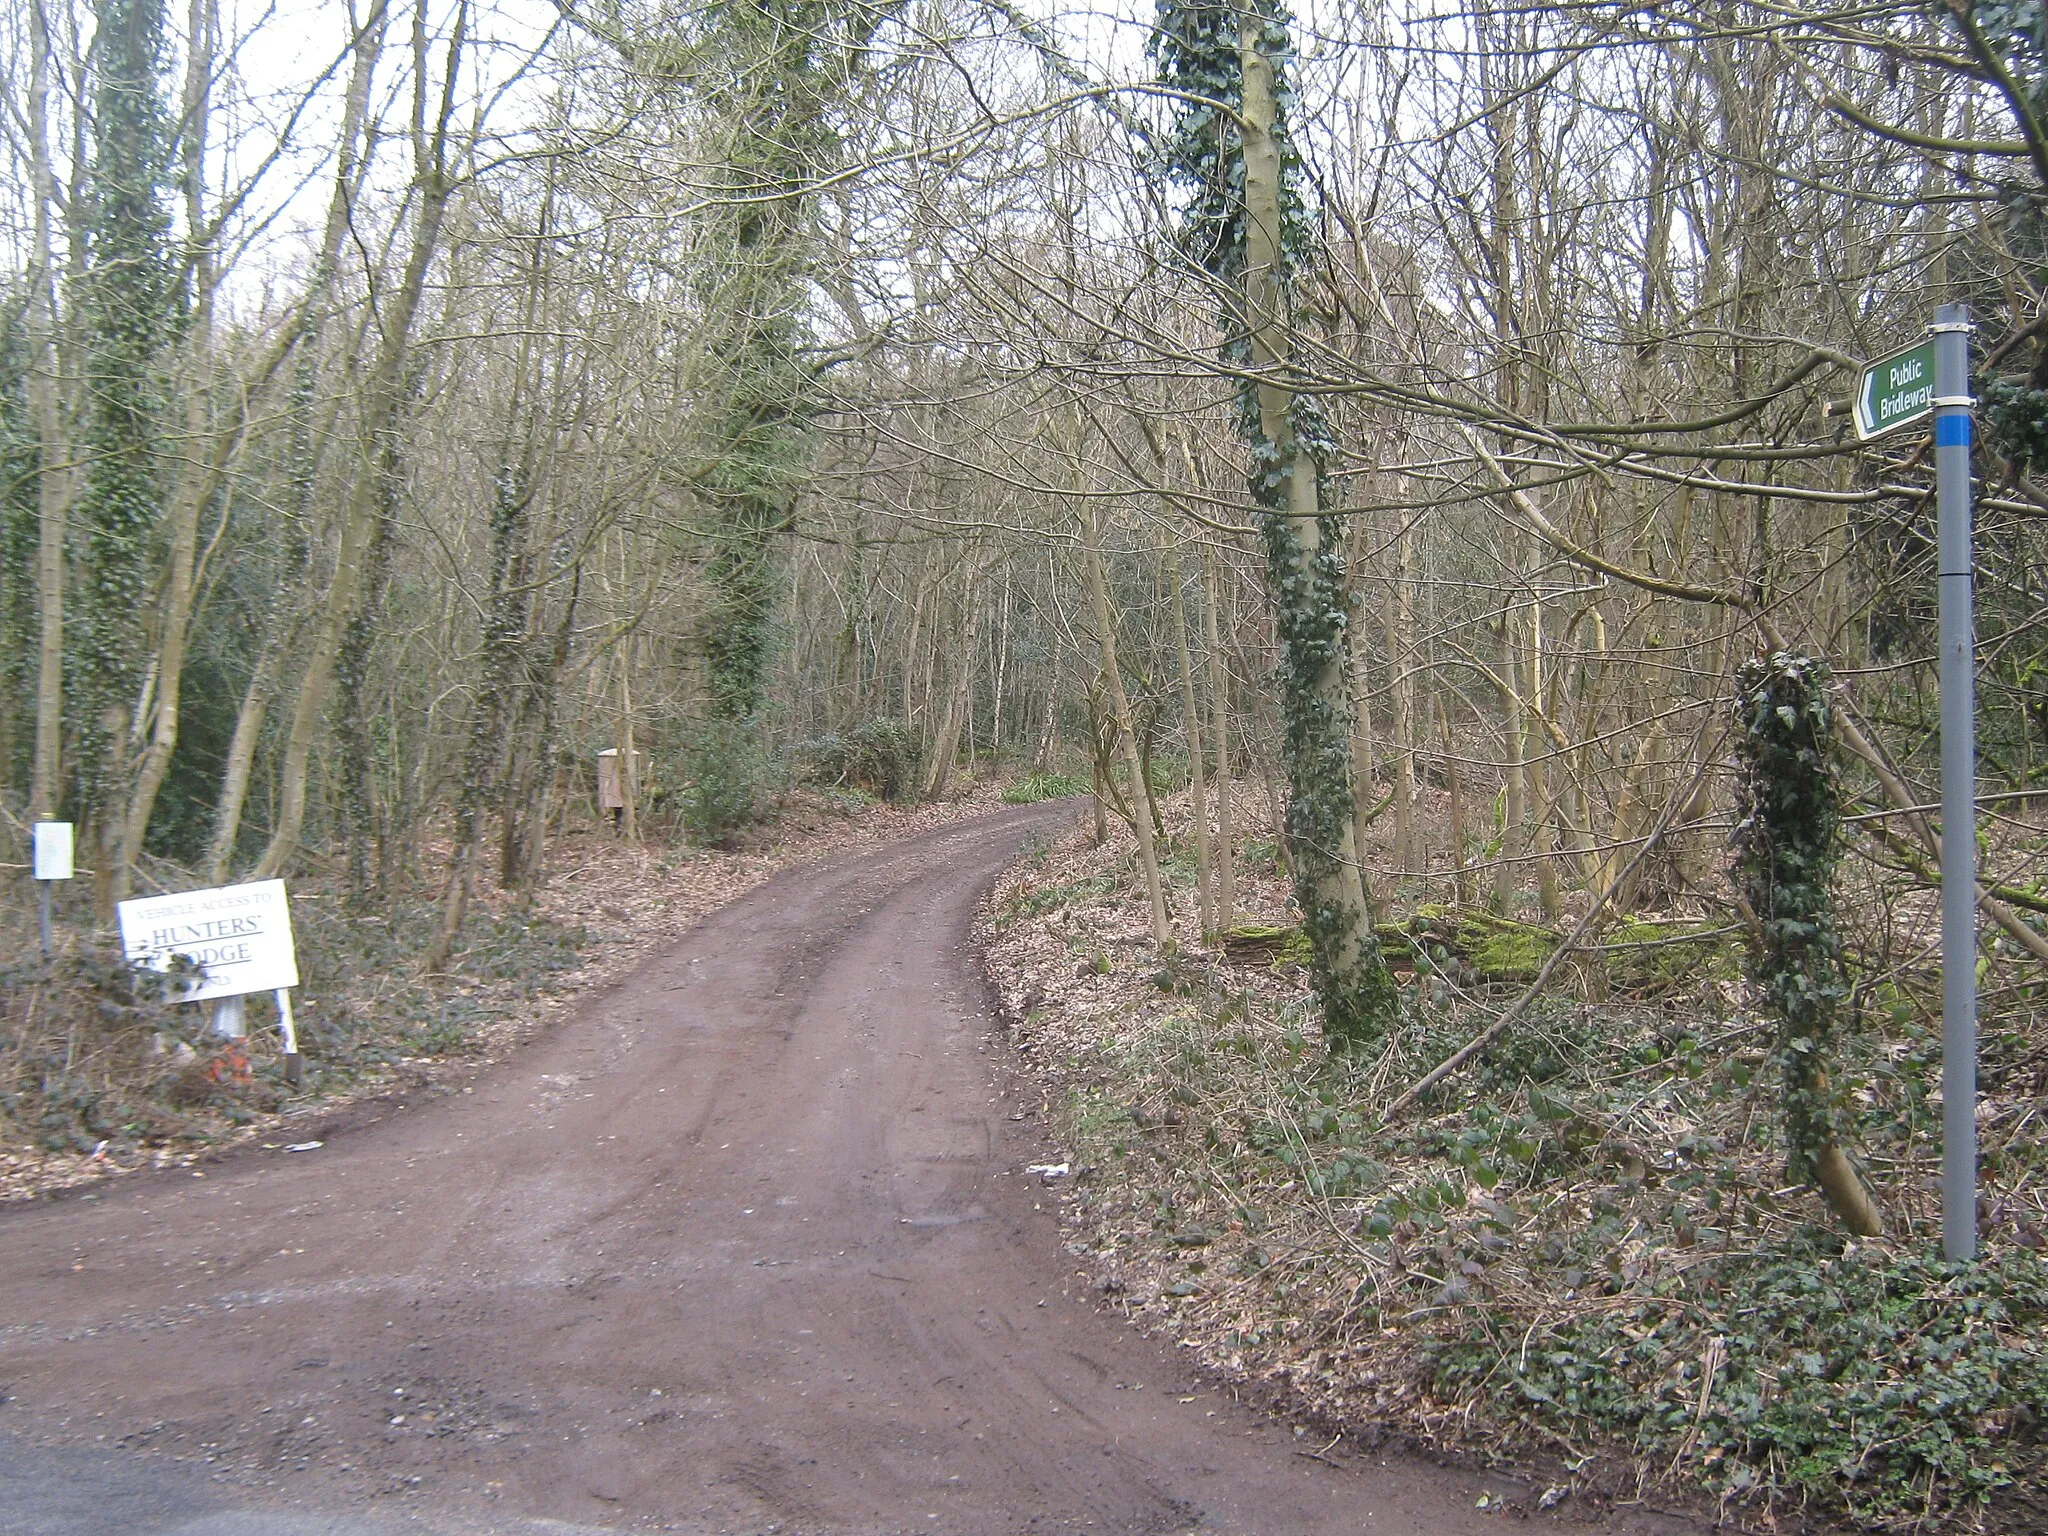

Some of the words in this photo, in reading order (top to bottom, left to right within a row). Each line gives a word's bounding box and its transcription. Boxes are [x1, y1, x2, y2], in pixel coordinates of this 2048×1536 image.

[1890, 359, 1922, 390] Public
[1880, 384, 1933, 420] Bridleway
[137, 905, 195, 919] VEHICLE
[202, 897, 250, 911] ACCESS
[254, 893, 271, 904] TO
[184, 942, 251, 964] ODGE
